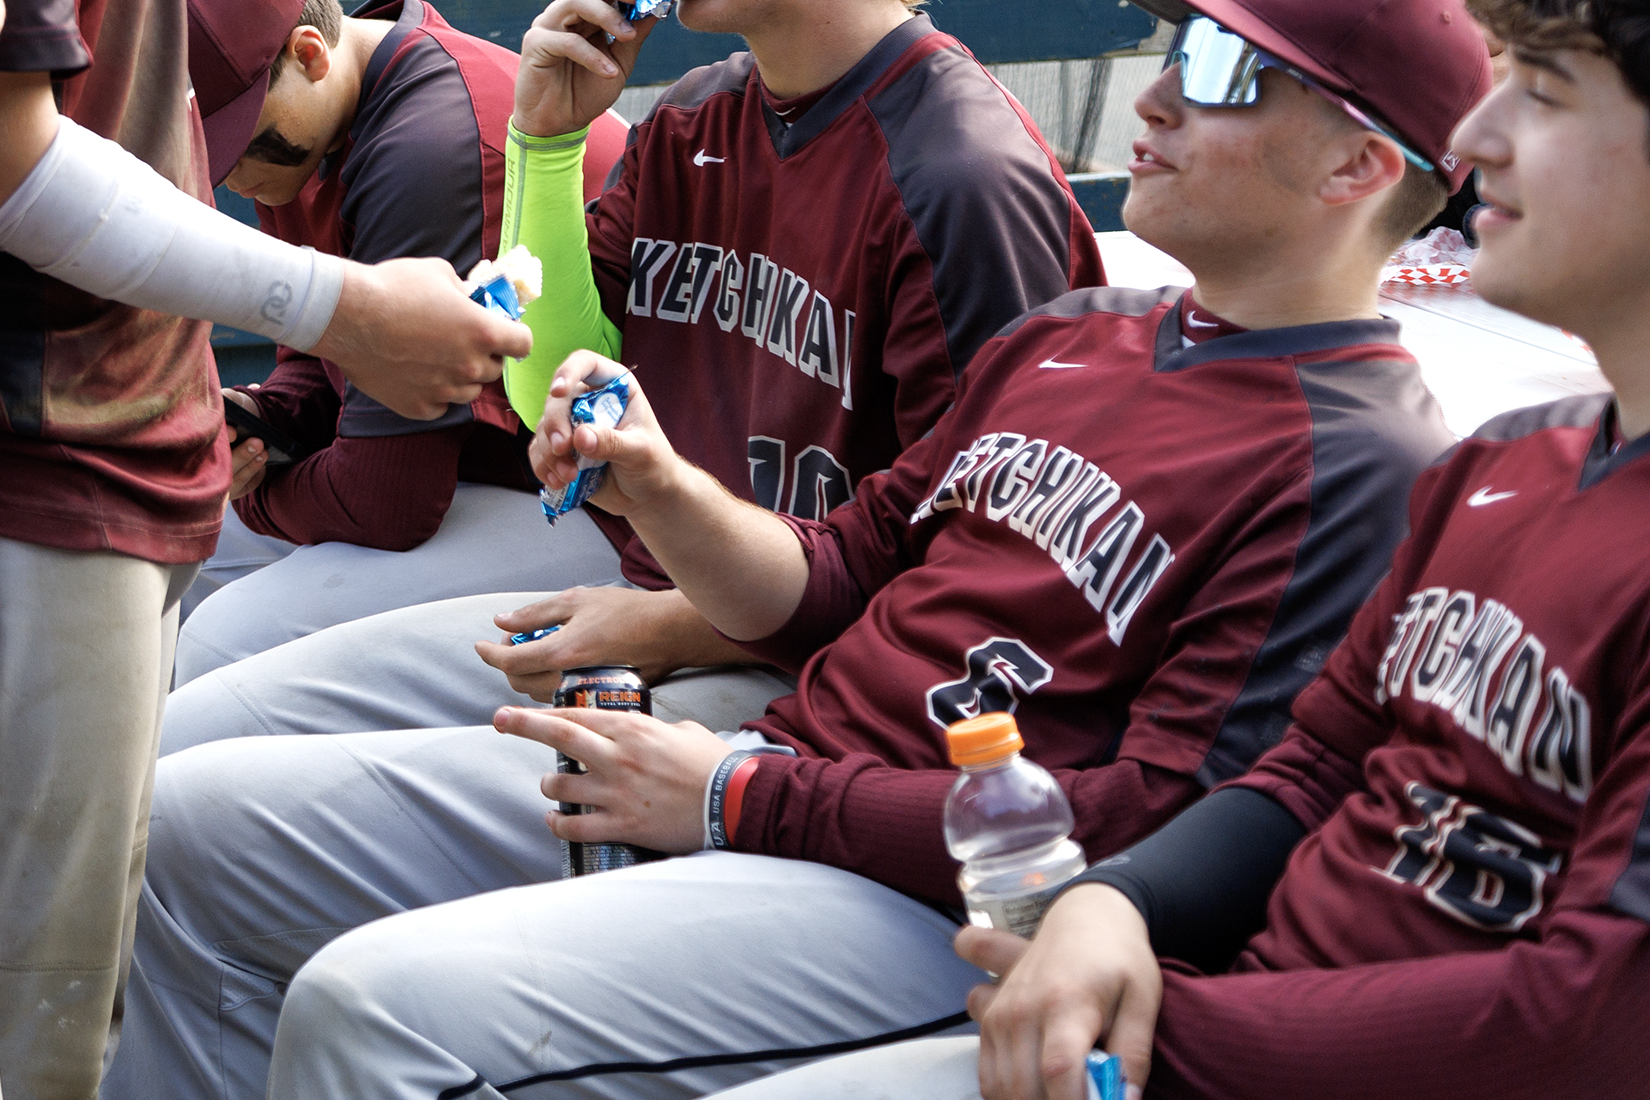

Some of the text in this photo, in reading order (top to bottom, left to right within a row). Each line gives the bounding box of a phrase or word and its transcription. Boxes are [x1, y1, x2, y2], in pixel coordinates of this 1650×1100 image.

[626, 237, 856, 411] KETCHKA
[910, 432, 1176, 647] ETCHIKAN
[577, 676, 633, 686] ELECTROL
[599, 691, 641, 703] REIGN
[713, 756, 739, 814] USA BASEBALL
